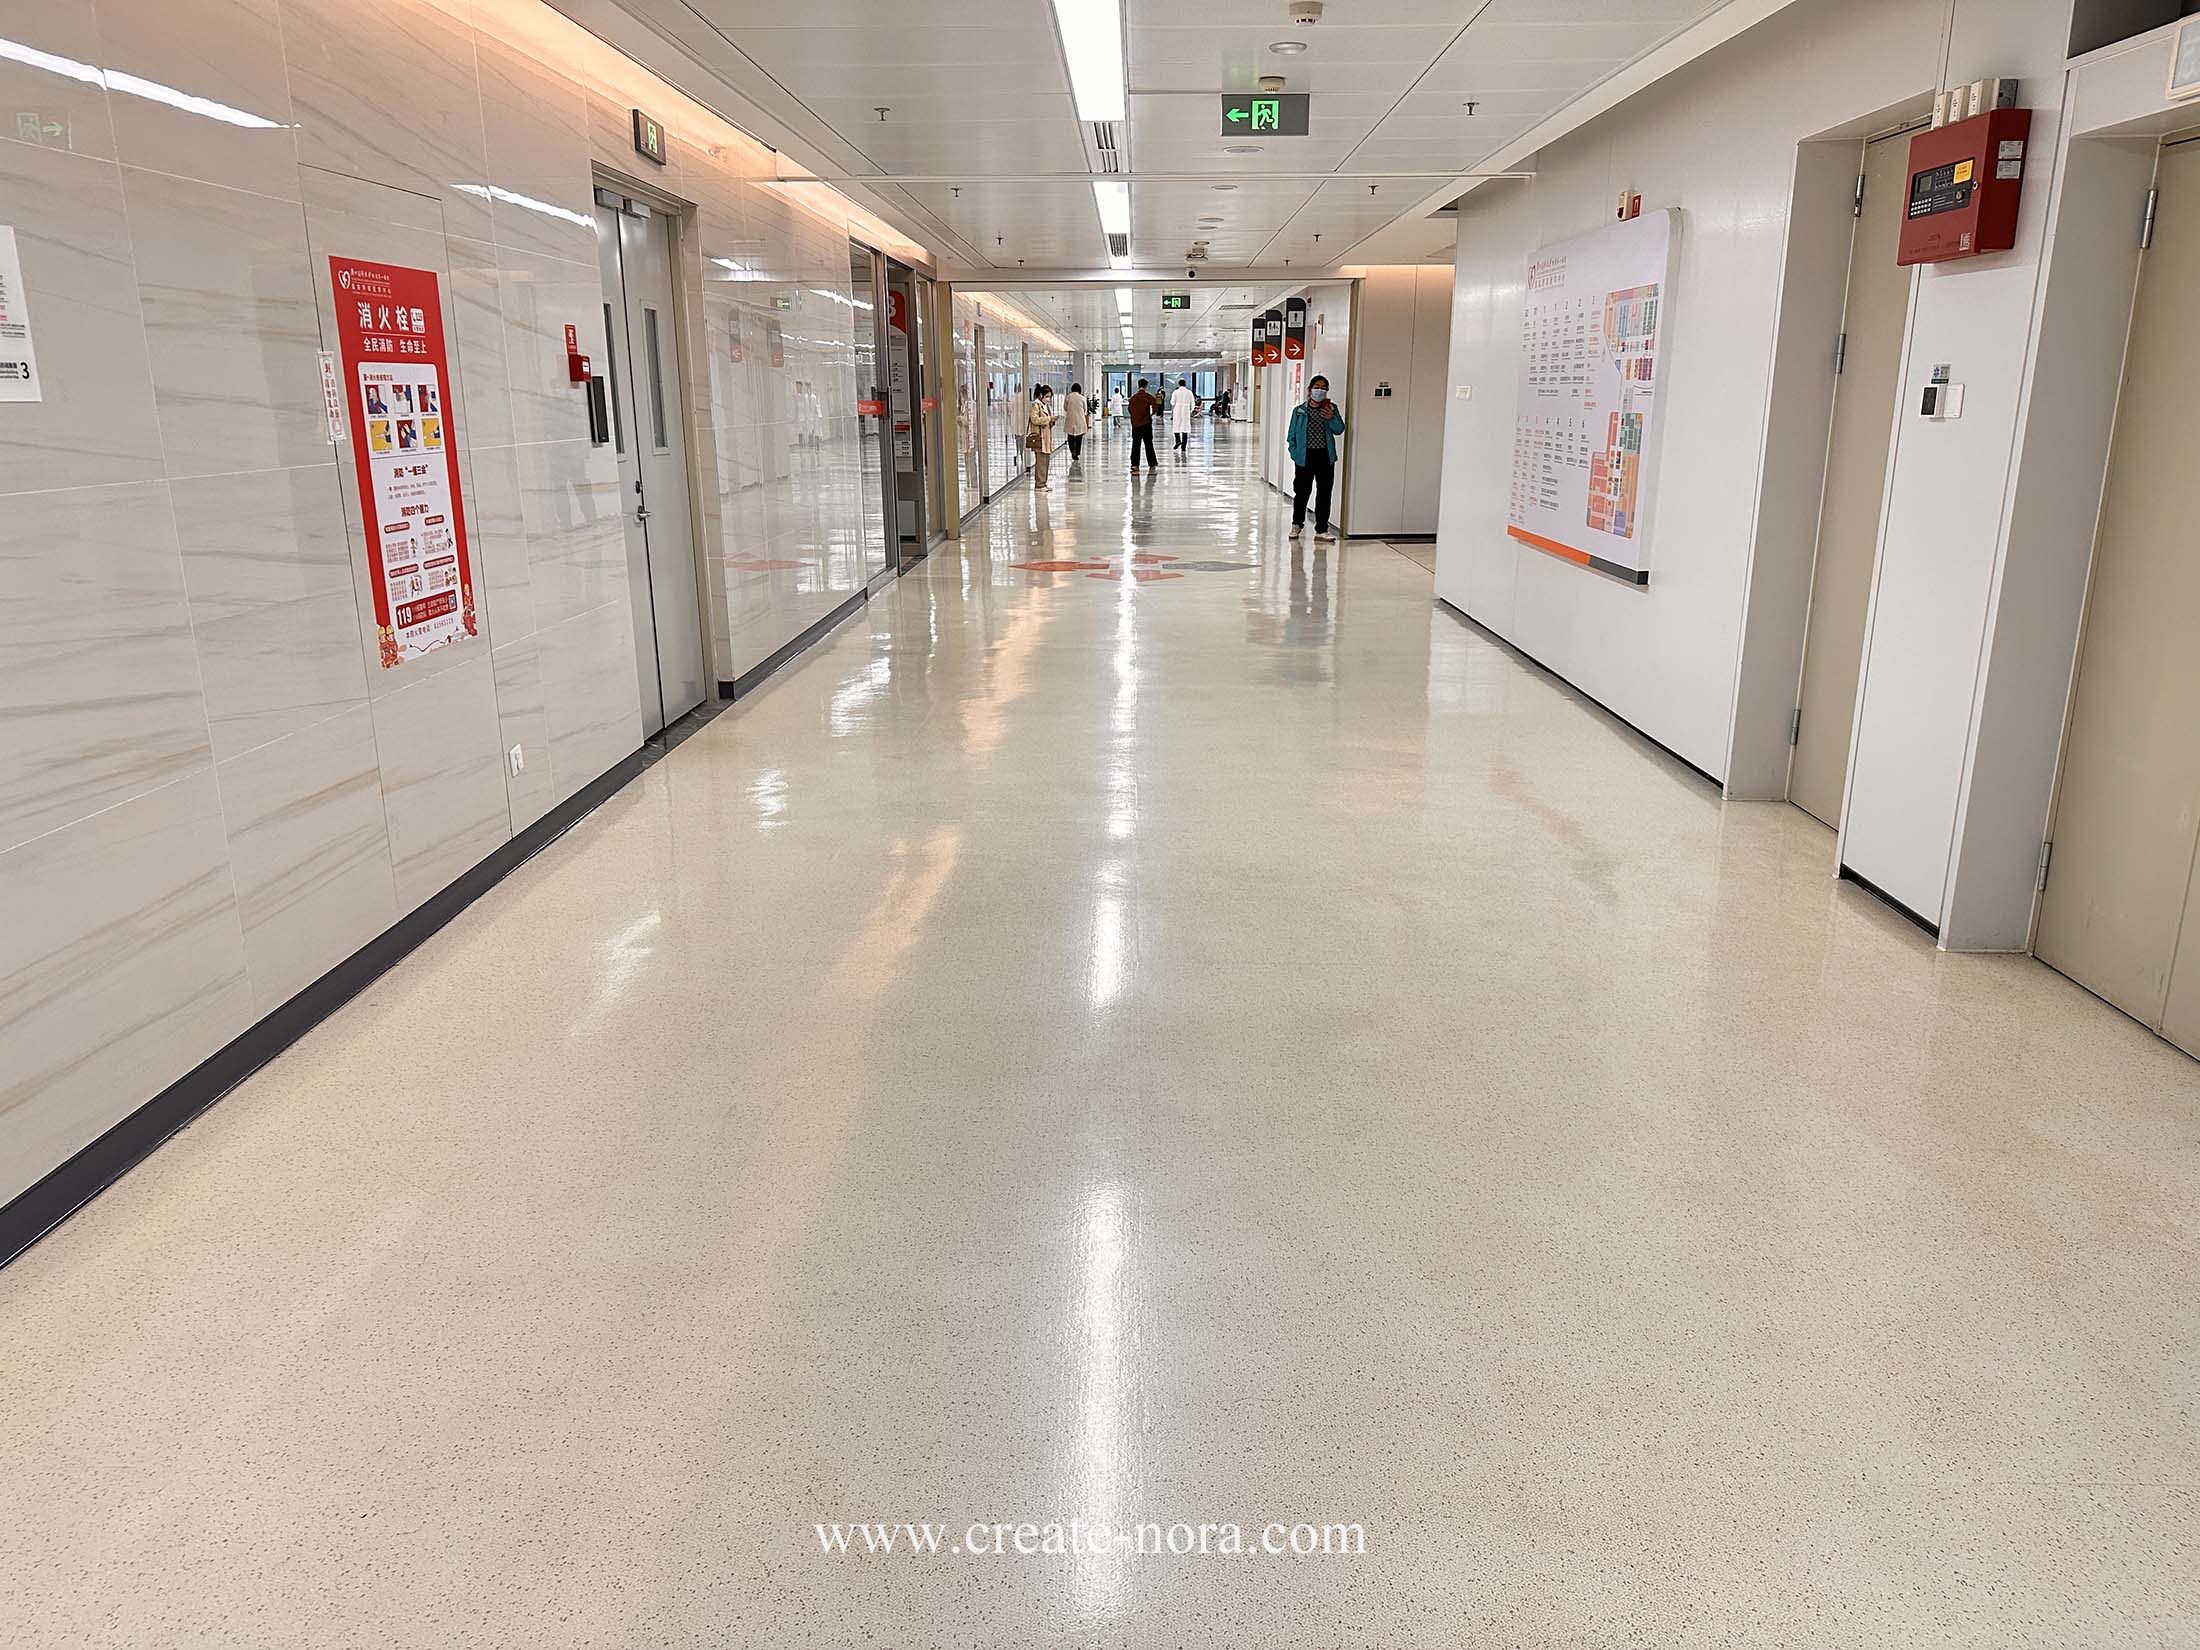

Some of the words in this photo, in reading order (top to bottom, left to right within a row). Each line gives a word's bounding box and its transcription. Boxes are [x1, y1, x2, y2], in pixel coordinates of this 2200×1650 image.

[357, 301, 409, 332] 消火栓
[363, 336, 394, 353] 全民消防
[399, 338, 428, 354] 生命至上
[20, 361, 30, 380] 3
[396, 606, 413, 626] 119
